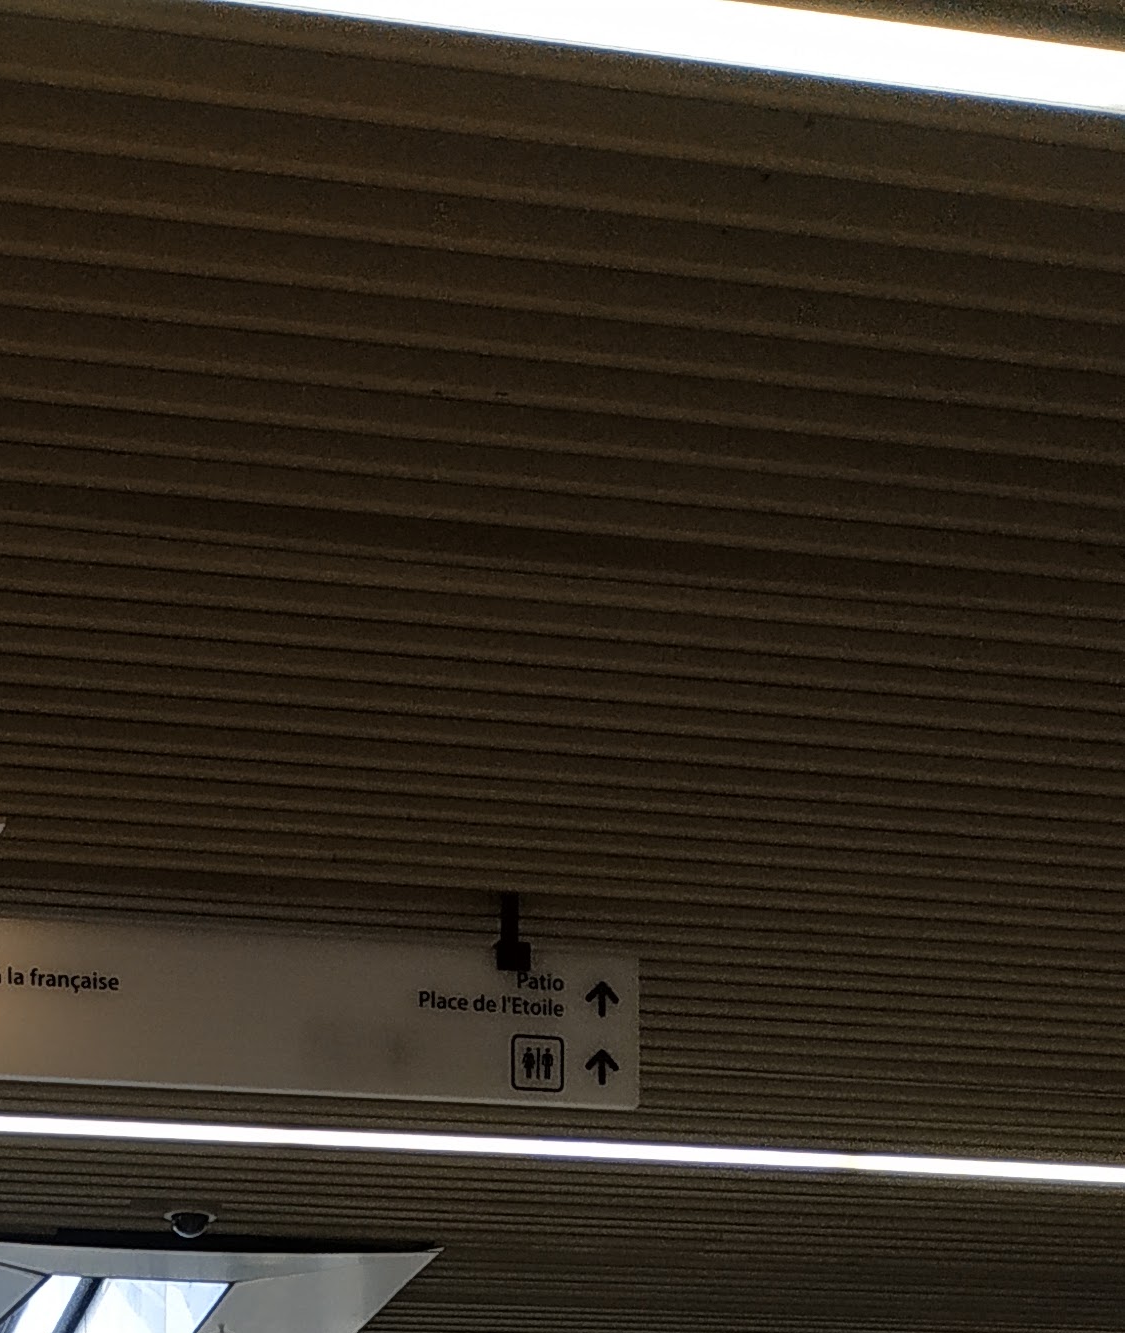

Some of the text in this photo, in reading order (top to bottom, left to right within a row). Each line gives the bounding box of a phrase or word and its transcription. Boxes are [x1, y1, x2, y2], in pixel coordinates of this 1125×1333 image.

[8, 966, 24, 985] la
[30, 968, 119, 993] française
[517, 972, 564, 992] Patio
[418, 991, 564, 1017] Place de l'Etoile
